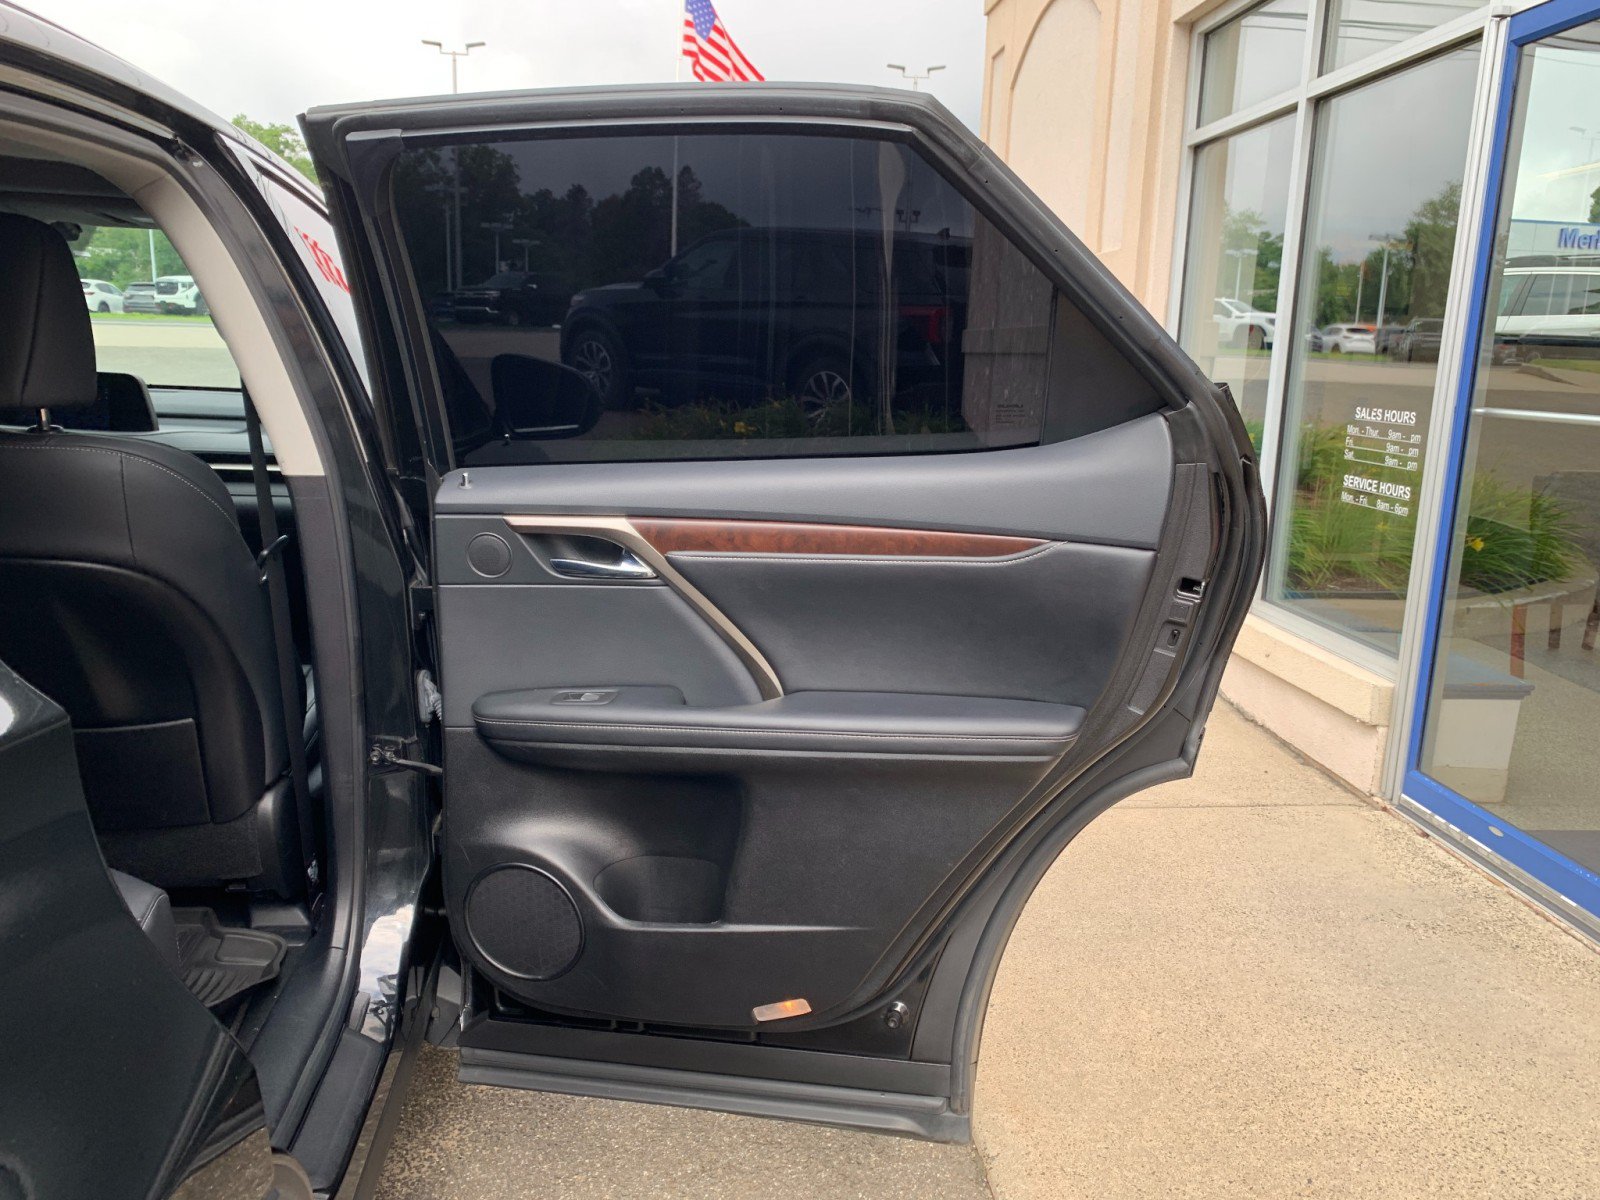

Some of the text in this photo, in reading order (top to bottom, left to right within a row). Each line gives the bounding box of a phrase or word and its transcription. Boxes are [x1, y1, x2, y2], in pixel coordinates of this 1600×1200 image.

[1355, 407, 1416, 424] SALES HOURS
[1388, 430, 1401, 440] 9am
[1386, 443, 1399, 452] 9am
[1384, 456, 1398, 466] 9am
[1343, 474, 1411, 499] SERVICE HOURS
[1376, 499, 1389, 510] 8am
[1394, 503, 1408, 516] 6pm
